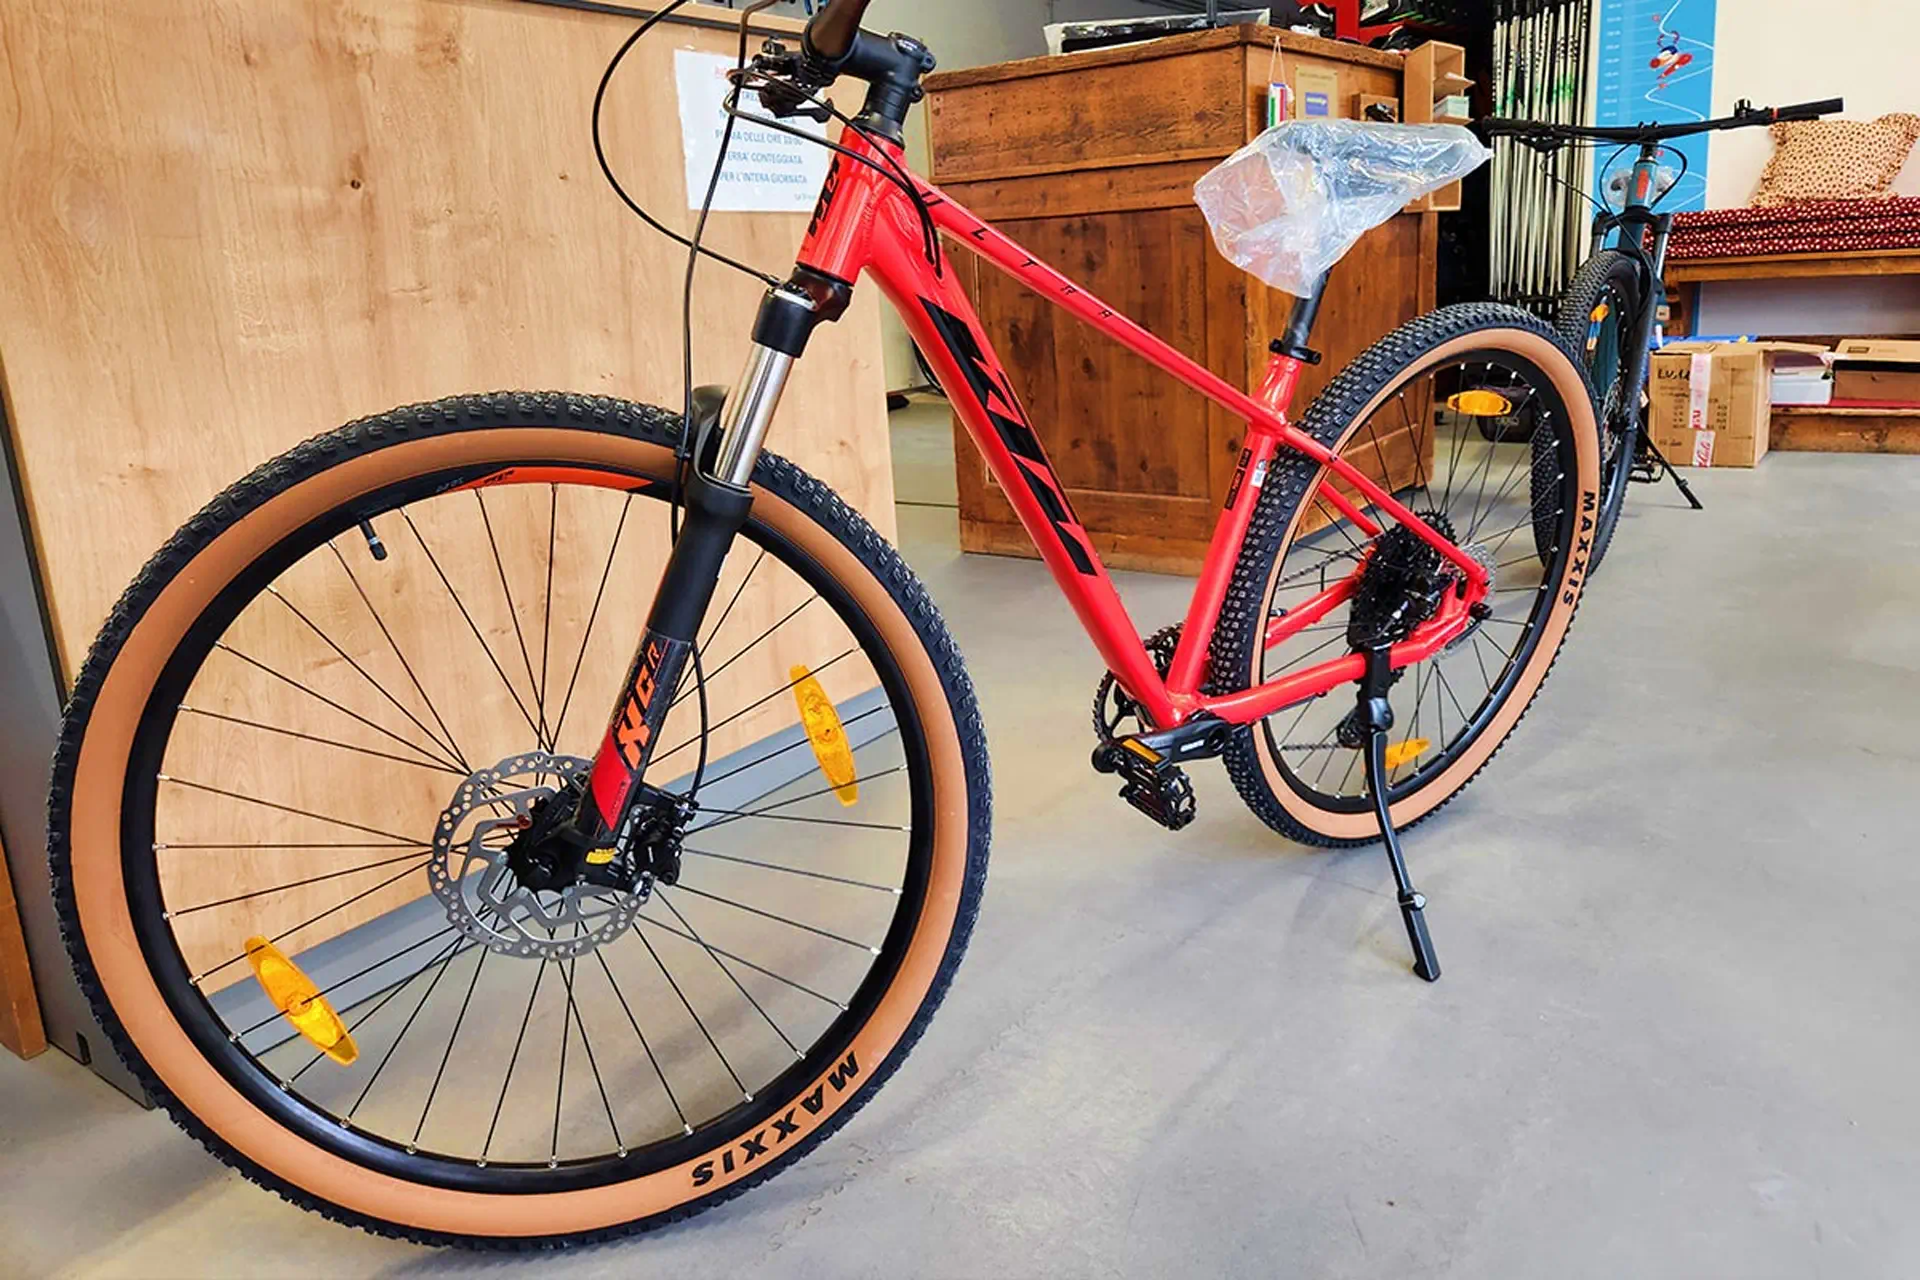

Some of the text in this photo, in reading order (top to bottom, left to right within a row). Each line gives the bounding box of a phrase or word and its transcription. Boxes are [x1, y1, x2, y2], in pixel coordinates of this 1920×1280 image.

[743, 131, 765, 143] DELLE
[727, 151, 803, 165] ERRA' CONTEGGIATA
[736, 171, 769, 184] L'INTERA
[770, 172, 807, 185] GIORNATA
[1562, 490, 1596, 606] MAXXIS
[691, 1050, 860, 1188] MAXXIS
